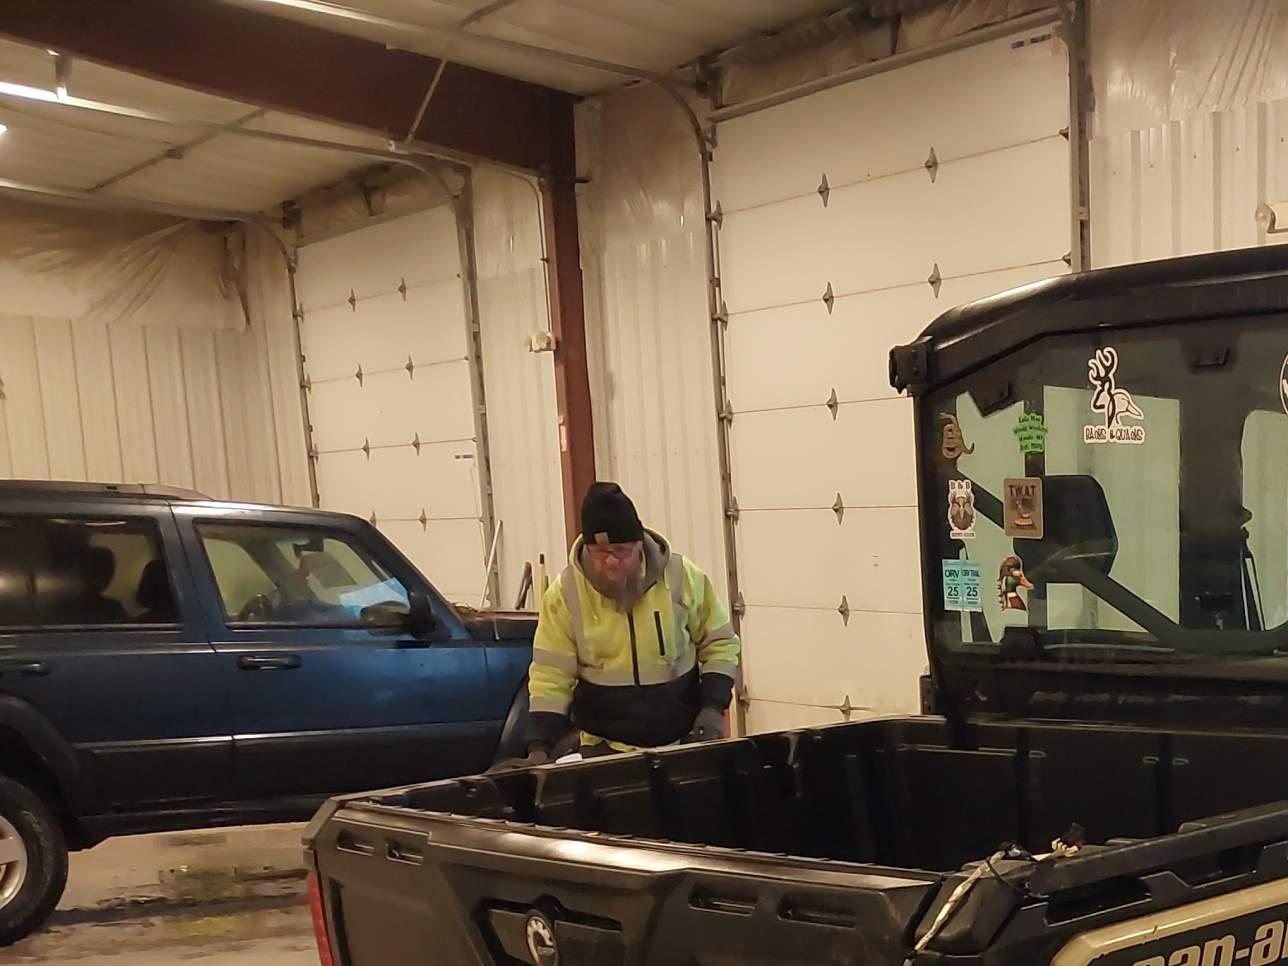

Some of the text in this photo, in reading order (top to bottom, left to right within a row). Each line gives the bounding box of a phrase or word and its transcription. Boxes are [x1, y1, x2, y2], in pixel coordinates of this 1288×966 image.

[944, 569, 960, 578] ORV
[947, 586, 960, 597] 25
[966, 586, 978, 597] 25
